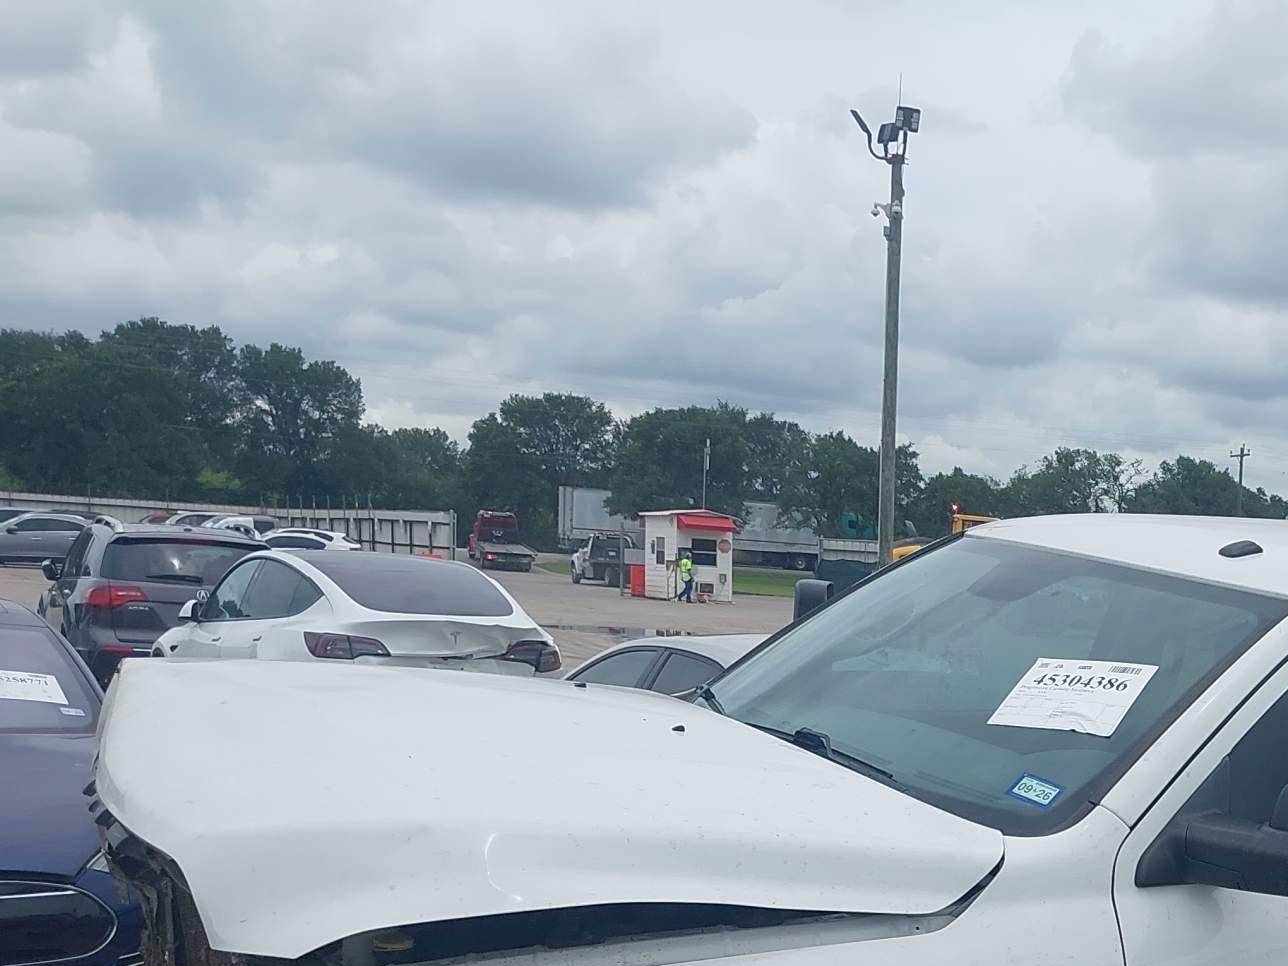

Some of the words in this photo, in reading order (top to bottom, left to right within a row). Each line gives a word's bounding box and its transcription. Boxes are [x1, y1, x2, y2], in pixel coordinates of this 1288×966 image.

[1033, 673, 1132, 692] 45304386
[1017, 782, 1034, 793] 09
[1034, 789, 1053, 801] 26
